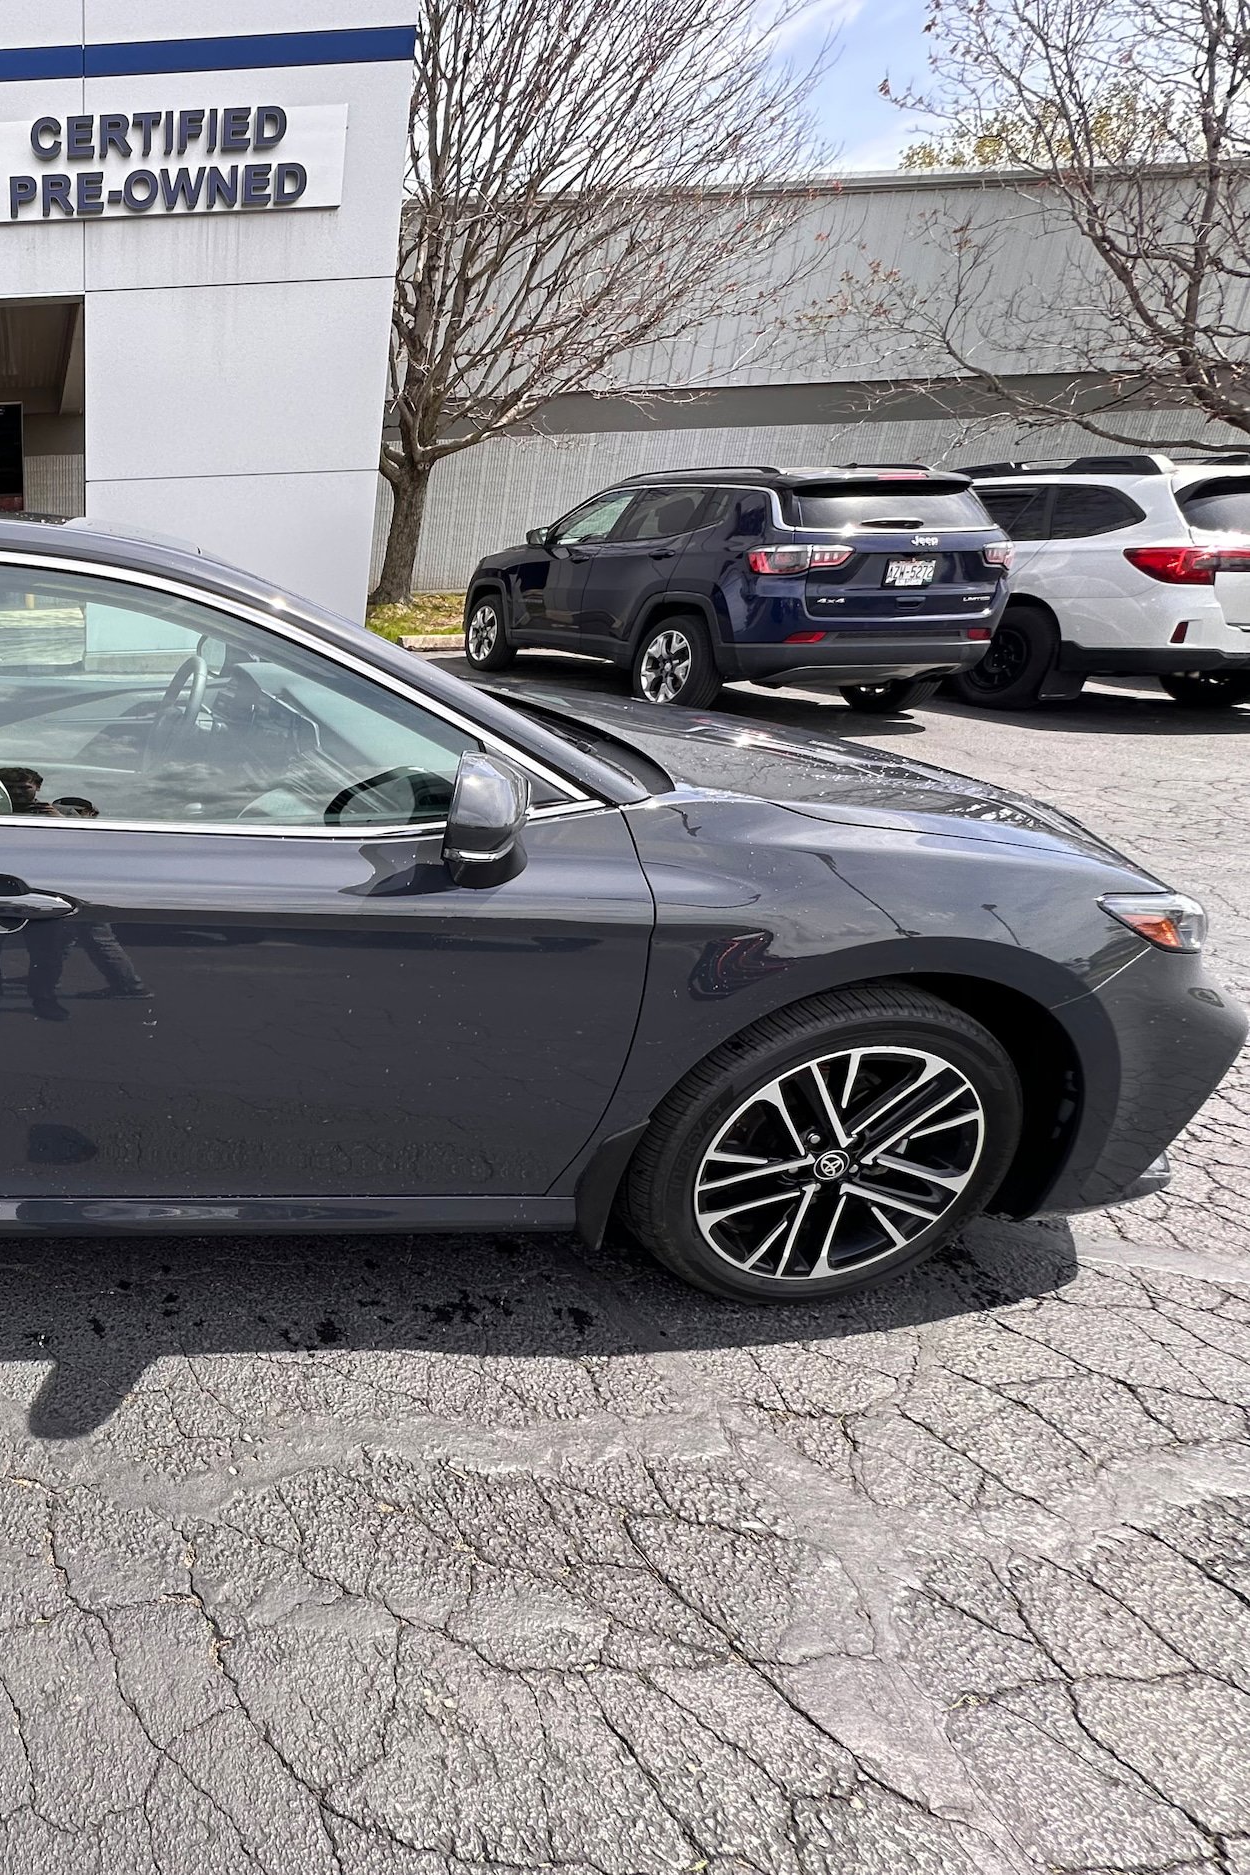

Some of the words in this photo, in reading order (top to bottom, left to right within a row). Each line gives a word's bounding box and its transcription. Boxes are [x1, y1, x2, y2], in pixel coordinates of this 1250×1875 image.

[30, 105, 288, 160] CERTIFIED
[9, 162, 308, 218] PRE-OWNED
[910, 535, 939, 547] Jeep
